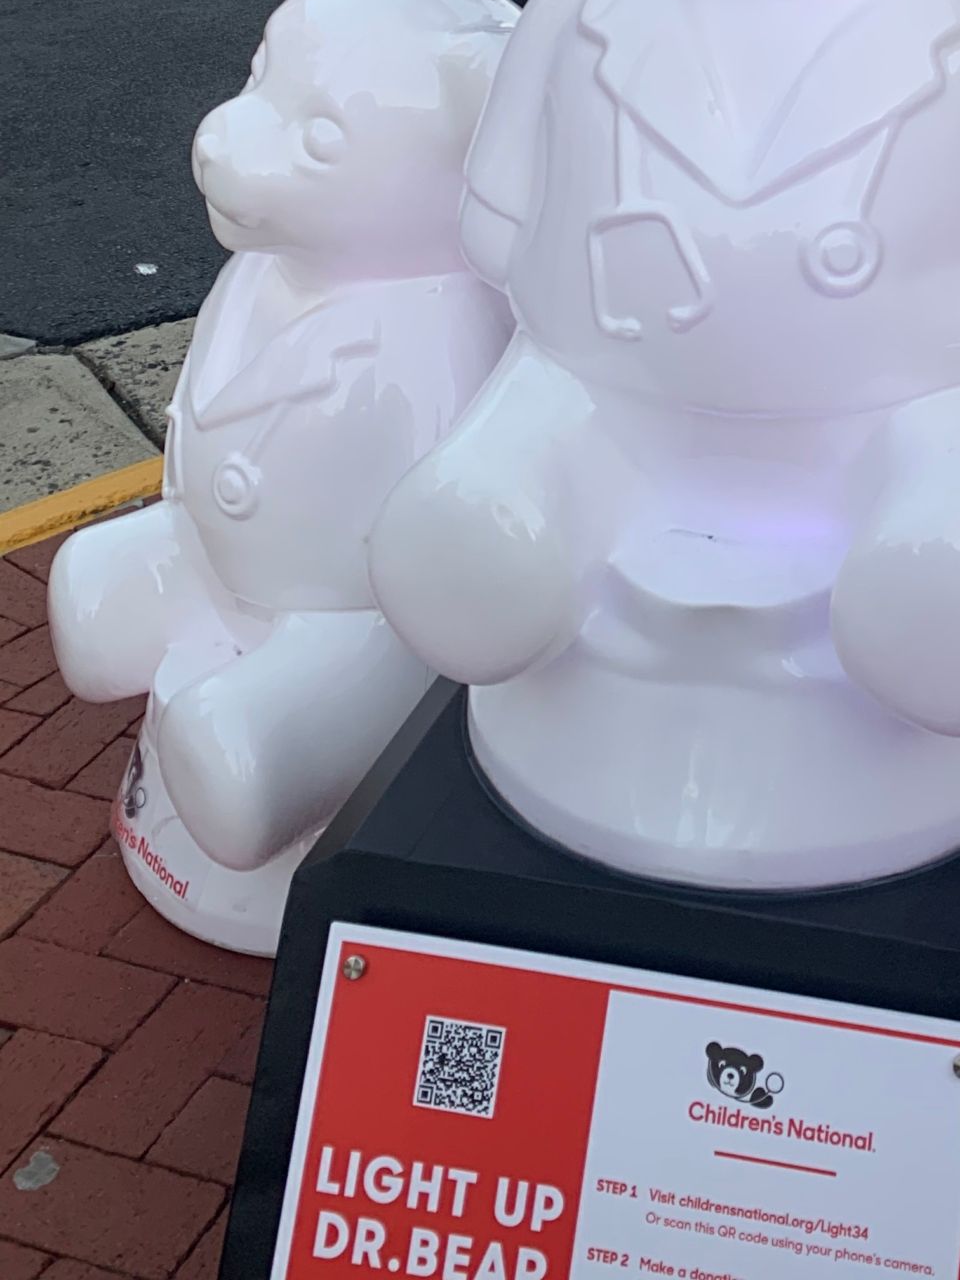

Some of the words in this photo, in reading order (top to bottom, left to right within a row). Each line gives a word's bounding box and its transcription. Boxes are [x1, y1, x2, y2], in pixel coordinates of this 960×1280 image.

[688, 1101, 784, 1136] Children's
[316, 1146, 478, 1217] LIGHT
[494, 1177, 564, 1232] UP
[596, 1179, 628, 1196] STEP
[629, 1185, 638, 1198] 1
[649, 1188, 676, 1206] Visit
[679, 1196, 869, 1240] childrensnational.org/Light34
[586, 1247, 618, 1265] STEP
[620, 1253, 630, 1268] 2
[639, 1257, 674, 1277] Make
[677, 1267, 687, 1278] a
[645, 1211, 662, 1225] Or
[664, 1217, 692, 1232] scan
[694, 1222, 715, 1236] this
[717, 1225, 737, 1240] QR
[738, 1228, 769, 1246] code
[771, 1235, 803, 1255] using
[805, 1243, 832, 1257] your
[834, 1247, 882, 1266] phone's
[884, 1258, 935, 1277] camera.
